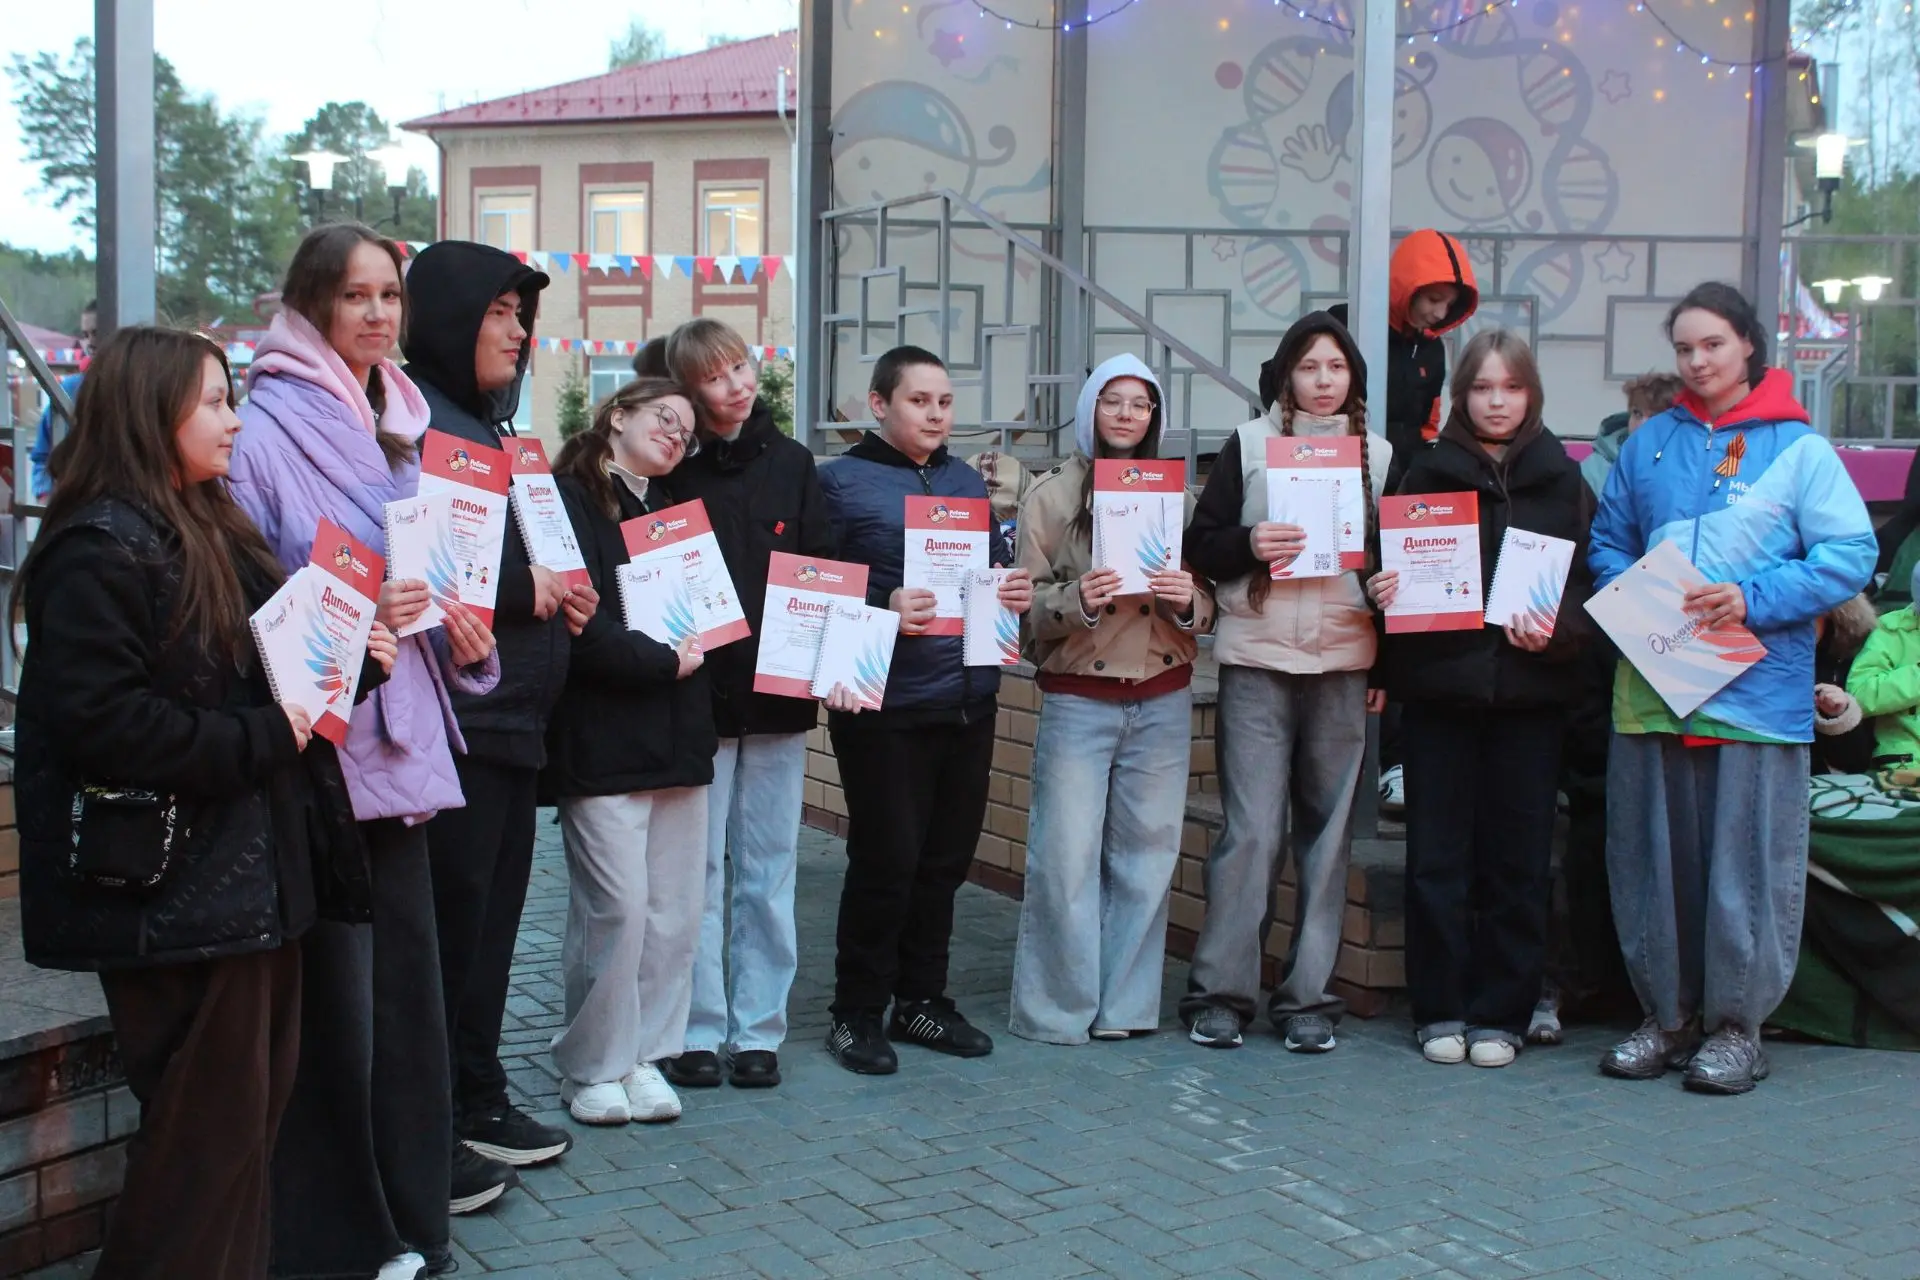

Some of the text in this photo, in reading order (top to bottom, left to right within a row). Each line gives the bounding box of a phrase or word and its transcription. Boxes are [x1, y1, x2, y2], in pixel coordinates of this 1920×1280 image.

[451, 497, 488, 517] плом
[924, 538, 972, 552] Диплом
[1403, 536, 1458, 551] Диплом
[321, 585, 361, 622] Диплом
[786, 597, 831, 613] Дипло
